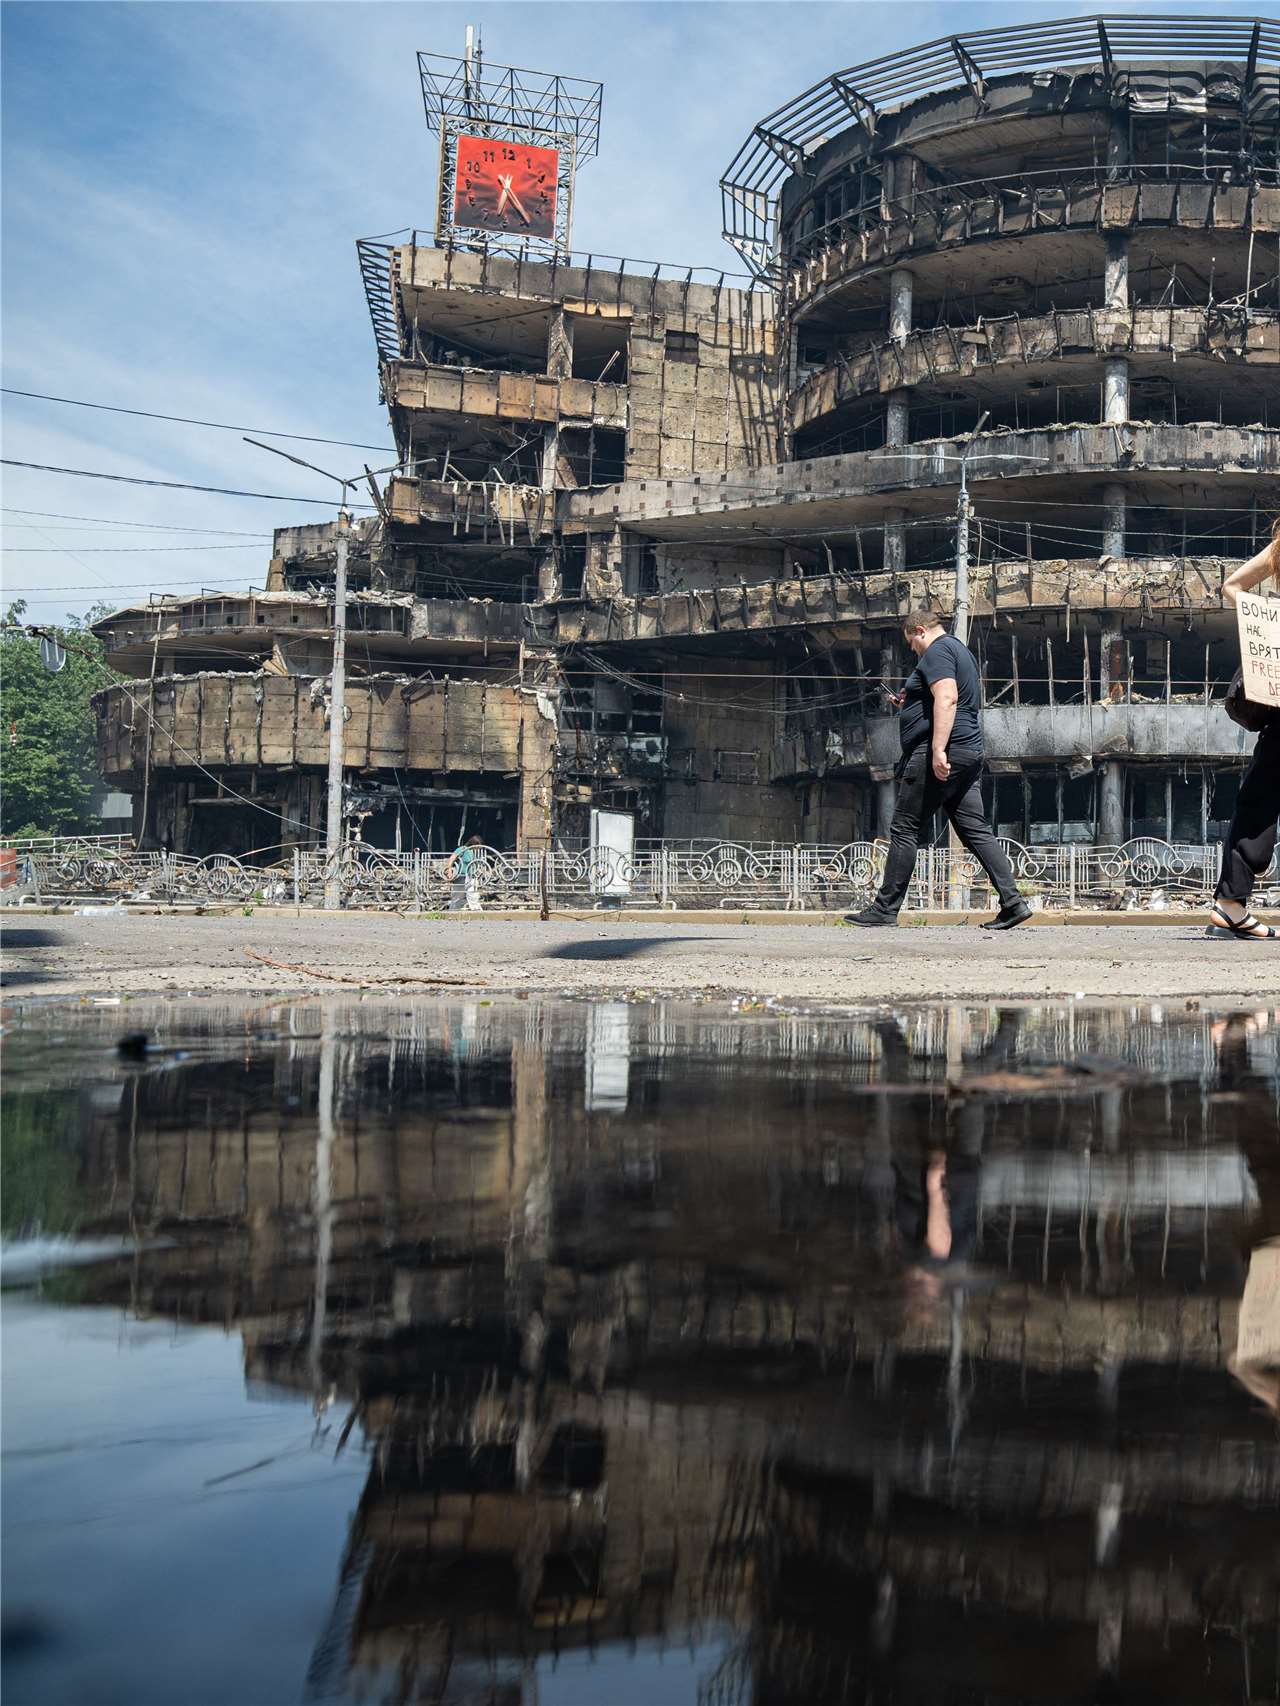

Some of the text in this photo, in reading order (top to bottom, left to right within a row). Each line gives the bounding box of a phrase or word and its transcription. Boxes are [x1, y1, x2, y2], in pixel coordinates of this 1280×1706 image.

[483, 150, 495, 163] 11
[502, 148, 516, 161] 12
[467, 160, 480, 173] 10
[1241, 601, 1279, 622] ВОНИ
